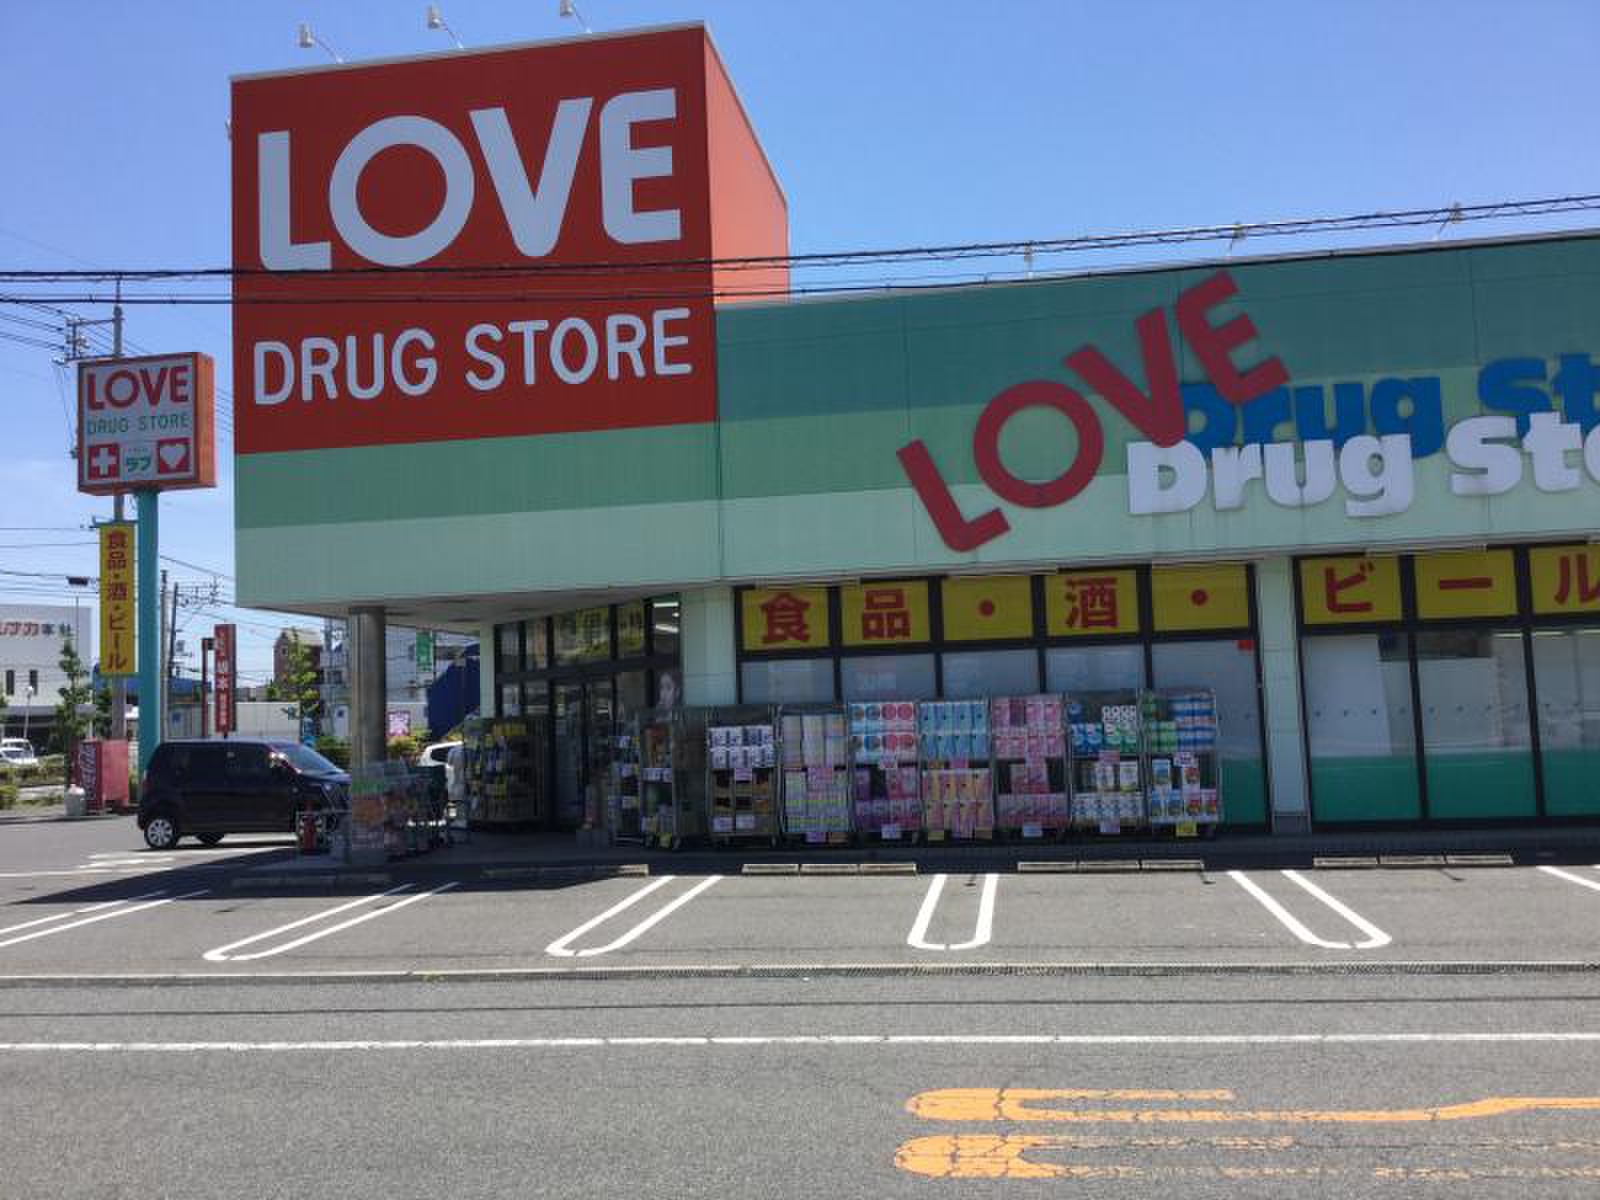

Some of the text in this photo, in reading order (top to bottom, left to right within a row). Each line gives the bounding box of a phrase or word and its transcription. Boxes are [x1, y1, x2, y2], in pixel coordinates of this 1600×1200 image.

[258, 88, 681, 271] LOVE
[87, 366, 189, 411] LOVE
[253, 308, 693, 406] DRUG STORE
[86, 412, 190, 435] DRUG STORE
[897, 270, 1289, 553] LOVE
[1127, 432, 1414, 518] Drug
[107, 530, 129, 670] 食品・酒・ビール
